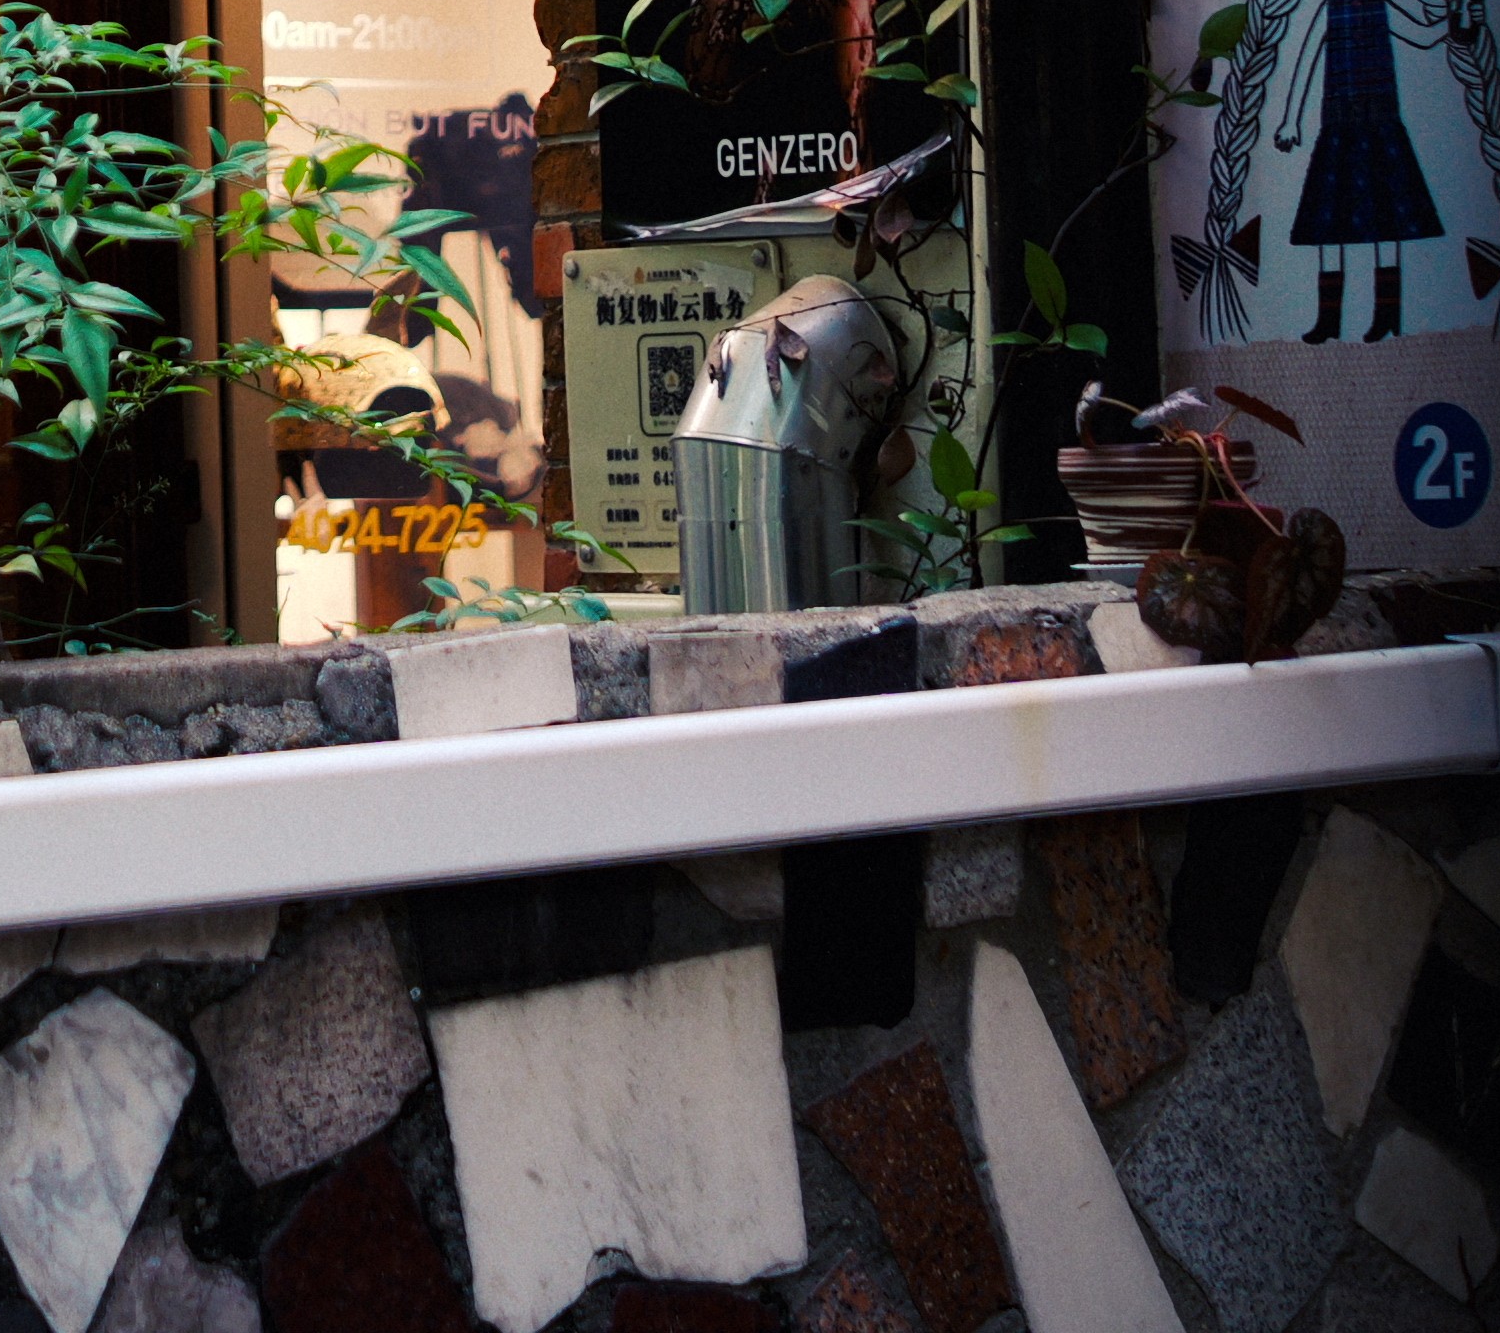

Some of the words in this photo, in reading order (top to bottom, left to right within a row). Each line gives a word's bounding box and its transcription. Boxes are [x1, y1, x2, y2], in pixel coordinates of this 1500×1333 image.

[716, 130, 859, 178] GENZERO
[596, 287, 745, 326] 衡复物业云服务
[1412, 424, 1475, 501] 2F
